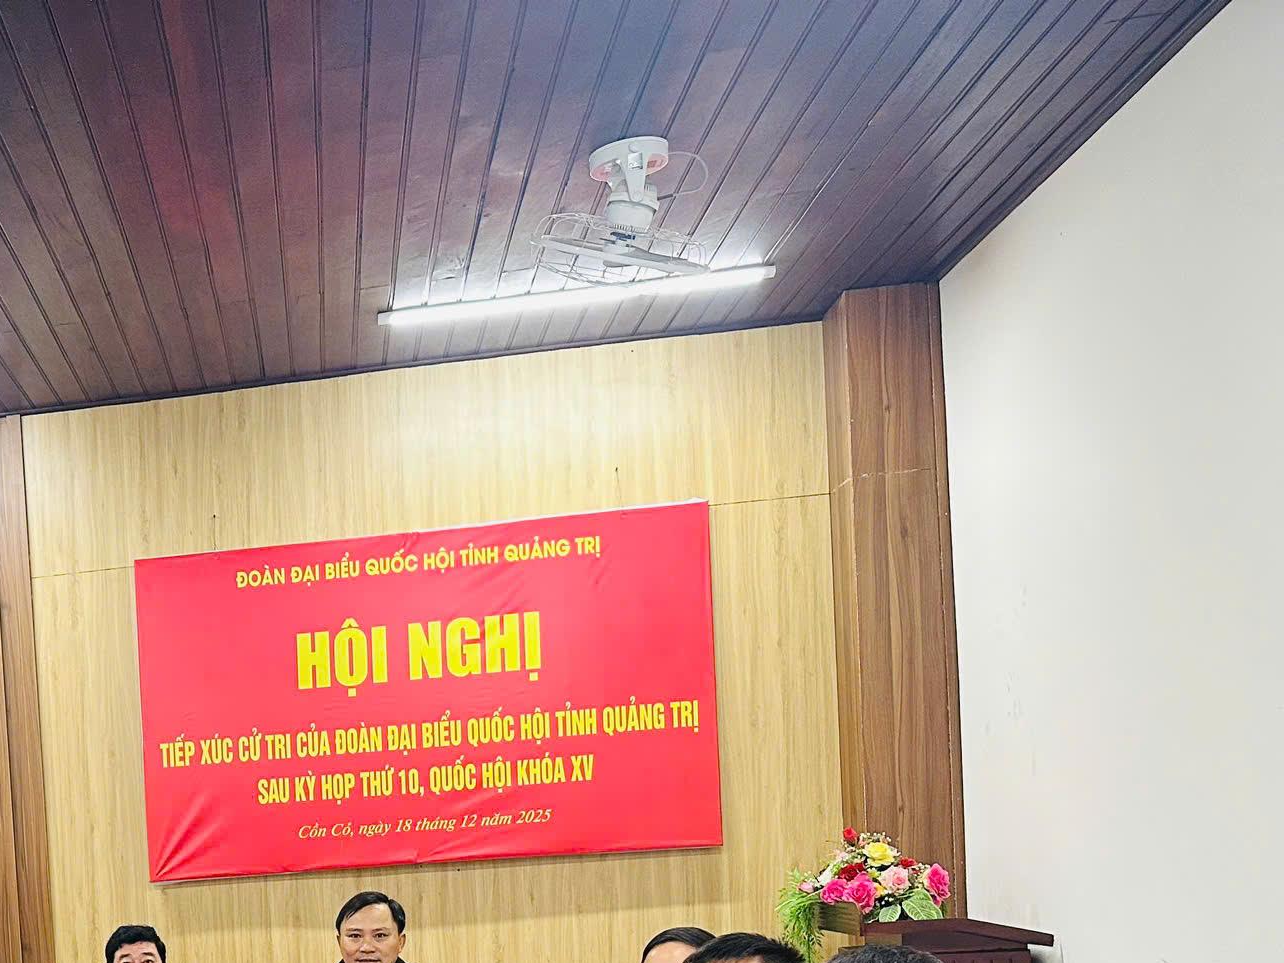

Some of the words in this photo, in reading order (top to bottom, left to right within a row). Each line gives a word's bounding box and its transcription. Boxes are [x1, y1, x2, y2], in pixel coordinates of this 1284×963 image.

[235, 564, 285, 588] ĐOÀN
[290, 563, 319, 586] ĐẠI
[324, 551, 360, 579] BIỂU
[364, 548, 418, 576] QUỐC
[423, 546, 455, 573] HỘI
[458, 542, 499, 566] TỈNH
[503, 535, 571, 562] QUẢNG
[574, 535, 600, 557] TRỊ
[296, 617, 388, 697] HỘI
[407, 610, 541, 681] NGHỊ
[159, 734, 195, 768] TIẾP
[199, 734, 233, 765] XÚC
[237, 727, 262, 762] CỬ
[264, 733, 291, 759] TRI
[296, 722, 331, 758] CỦA
[334, 722, 382, 754] ĐOÀN
[386, 723, 416, 755] ĐẠI
[421, 709, 462, 748] BIỂU
[466, 706, 514, 747] QUỐC
[519, 706, 550, 744] HỘI
[554, 701, 597, 737] TỈNH
[602, 695, 665, 736] QUẢNG
[669, 699, 698, 732] TRỊ
[257, 777, 289, 804] SAU
[294, 770, 316, 801] KỲ
[321, 772, 355, 804] HỌP
[359, 764, 394, 797] THỨ
[397, 767, 424, 796] 10,
[429, 754, 476, 795] QUỐC
[481, 755, 512, 793] HỘI
[516, 751, 566, 785] KHÓA
[570, 753, 593, 781] XV
[358, 821, 391, 837] ngày
[395, 818, 412, 832] 18
[415, 816, 456, 831] tháng
[461, 814, 477, 827] 12
[480, 812, 512, 826] năm
[515, 808, 551, 823] 2025
